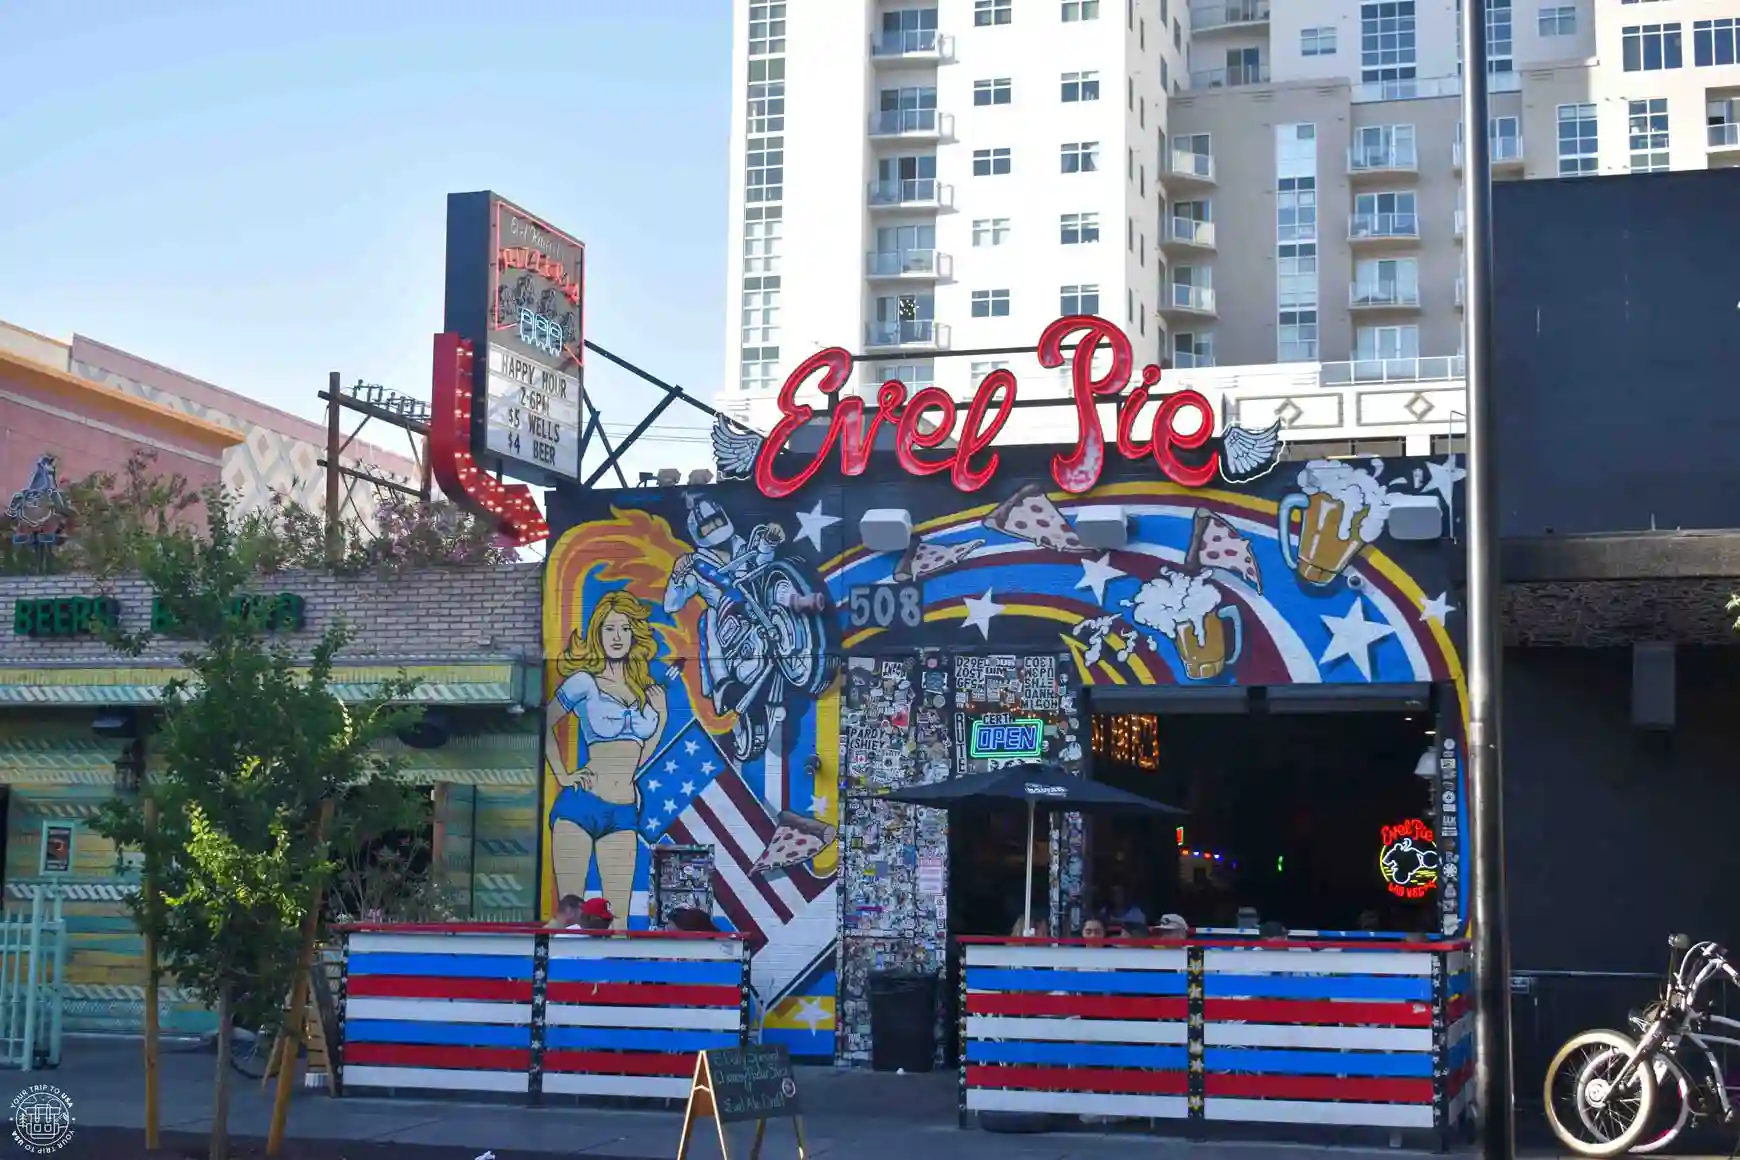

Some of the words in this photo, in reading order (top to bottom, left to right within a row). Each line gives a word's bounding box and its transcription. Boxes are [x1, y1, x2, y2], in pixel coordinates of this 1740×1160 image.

[502, 353, 536, 385] HAPPY
[542, 371, 567, 399] HOUR
[519, 386, 550, 416] 2-6PM
[755, 346, 1017, 498] Evel
[1037, 315, 1219, 494] Pie
[508, 407, 520, 428] $5
[528, 412, 560, 443] WELLS
[508, 431, 521, 454] $4
[533, 440, 556, 467] BEER
[850, 586, 921, 627] 508
[976, 726, 1037, 751] OPEN
[1381, 819, 1413, 847] Evel
[1411, 819, 1433, 842] Pie
